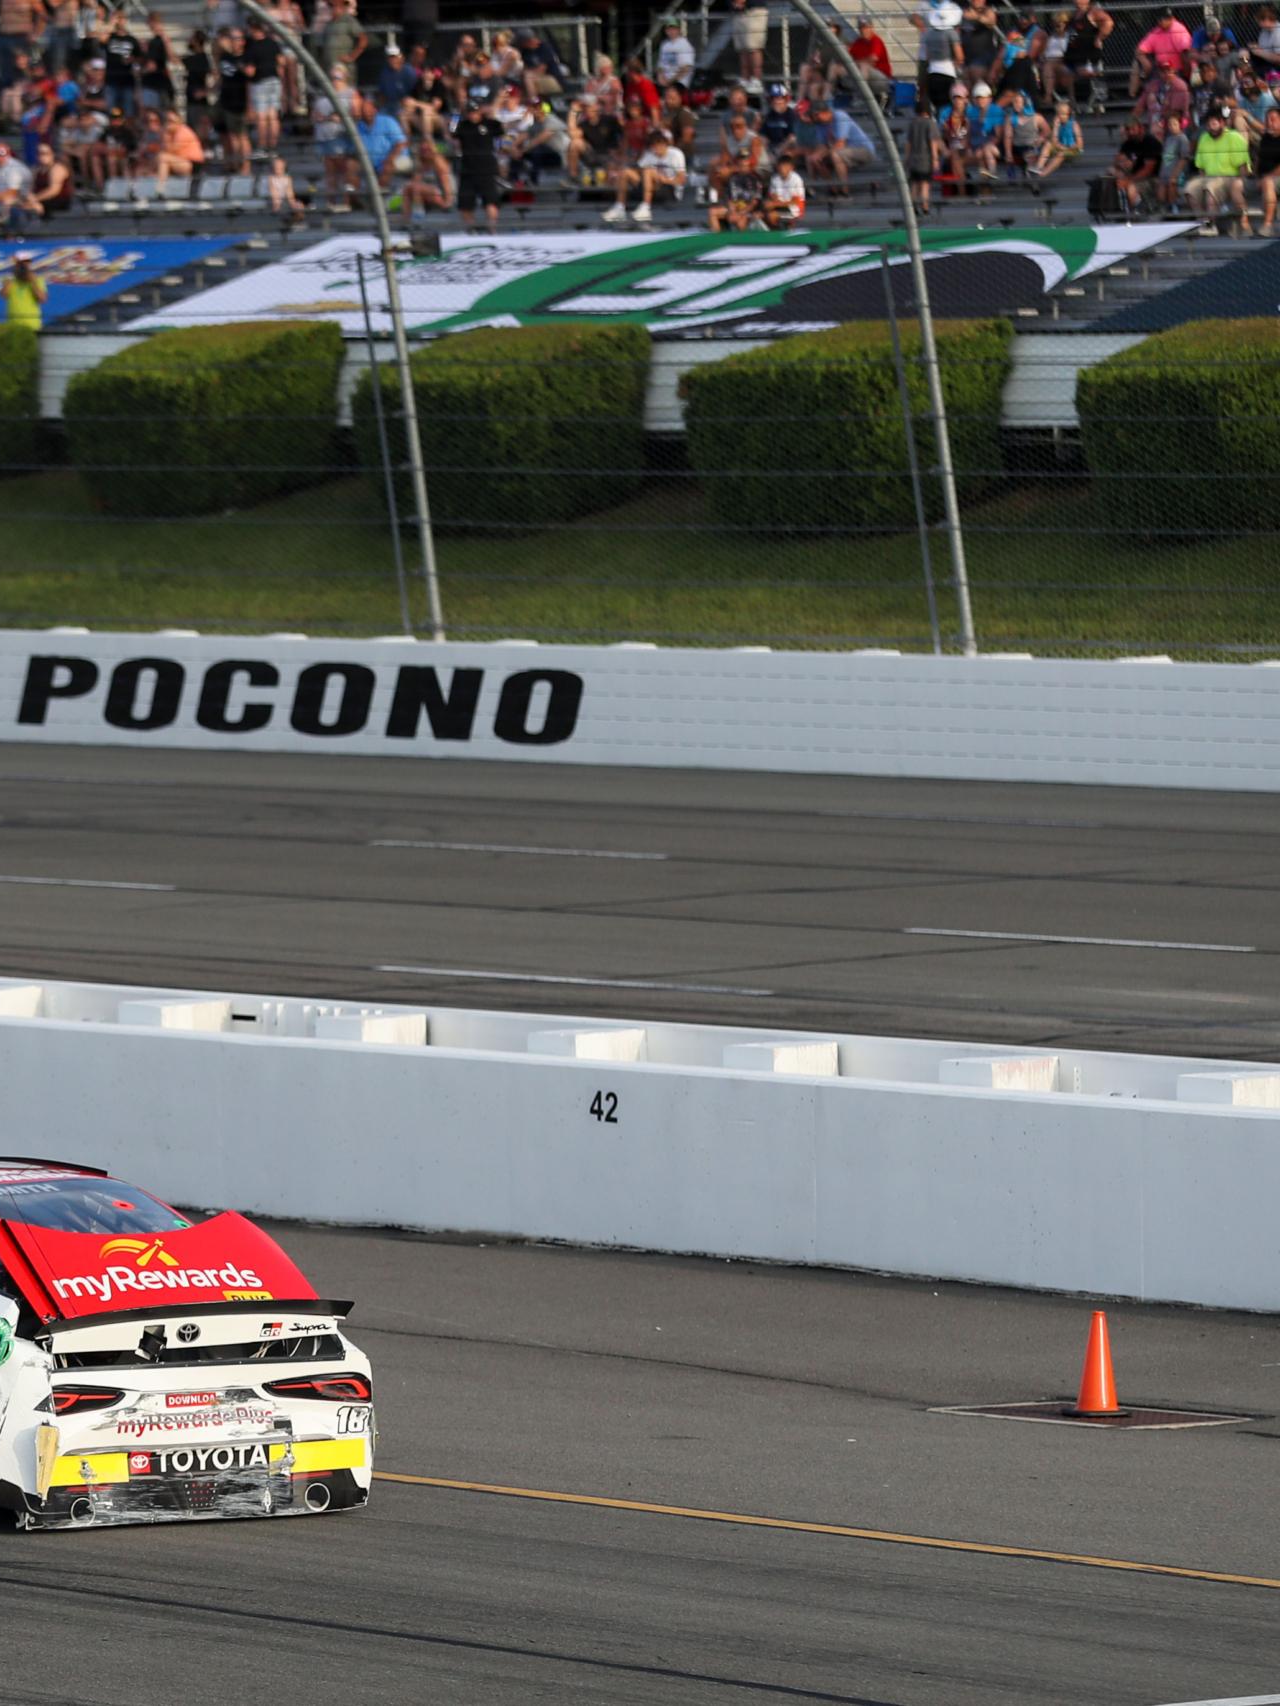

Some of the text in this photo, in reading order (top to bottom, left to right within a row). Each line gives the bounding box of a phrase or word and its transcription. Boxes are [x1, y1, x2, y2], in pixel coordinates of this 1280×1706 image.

[16, 655, 584, 746] POCONO
[589, 1090, 618, 1123] 42
[51, 1262, 264, 1301] myRewards
[288, 1322, 332, 1335] Supra
[336, 1405, 371, 1434] 18
[155, 1443, 269, 1473] TOYOTA
